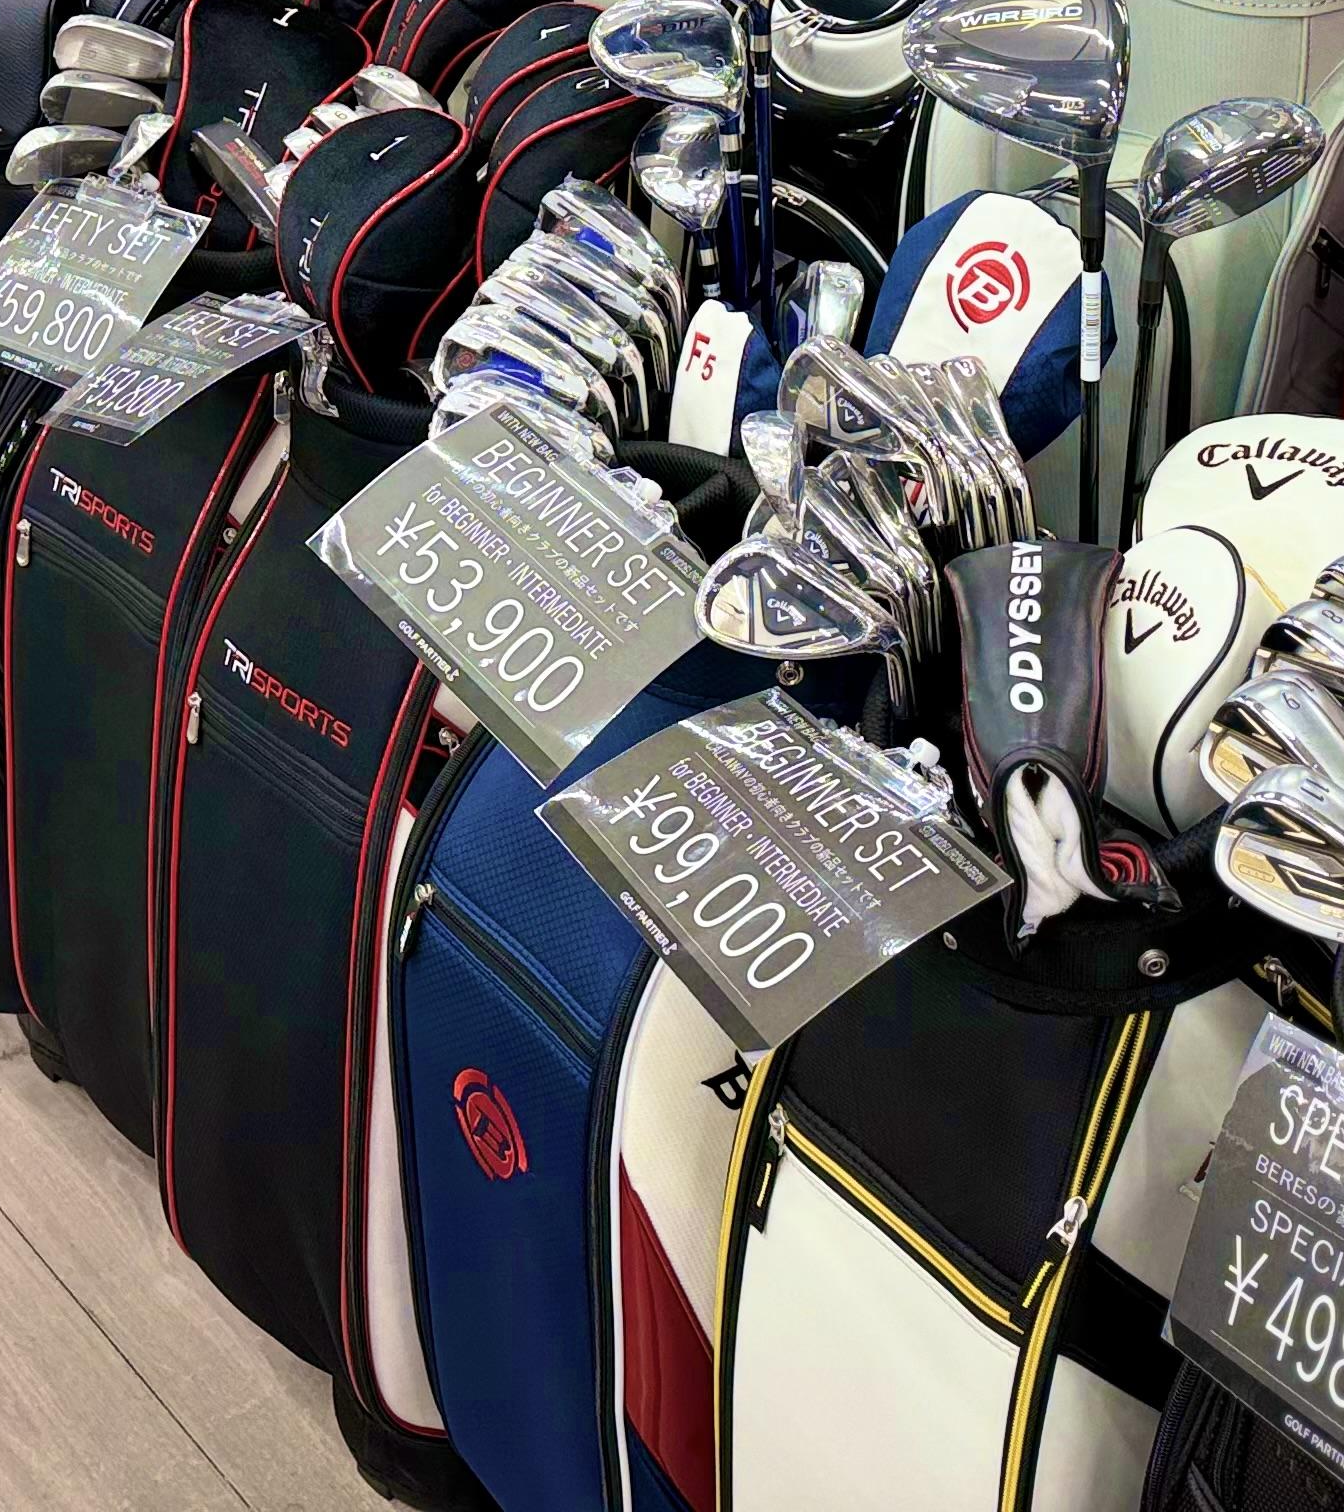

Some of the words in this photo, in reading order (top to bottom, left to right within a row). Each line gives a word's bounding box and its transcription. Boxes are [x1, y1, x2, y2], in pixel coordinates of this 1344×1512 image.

[958, 3, 1085, 32] WARBIRD
[29, 200, 106, 247] LEFTY
[106, 221, 171, 266] SET
[220, 321, 280, 349] SET
[78, 364, 186, 418] ¥59,800
[497, 409, 521, 435] WITH
[518, 427, 541, 450] NEW
[537, 442, 560, 464] BAG
[49, 466, 156, 556] TRISPORTS
[471, 438, 624, 568] BEGINNER
[607, 553, 687, 617] SET
[421, 482, 444, 505] for
[440, 493, 508, 565] BEGINNER
[507, 561, 613, 660] INTERMEDIATE
[376, 500, 586, 713] ¥53,900
[398, 619, 421, 641] GOLF
[1009, 539, 1045, 715] ODYSSEY
[1111, 569, 1202, 644] Callaway
[1321, 609, 1343, 625] 8
[222, 638, 353, 748] TRISPORTS
[735, 720, 880, 843] BEGINNER
[853, 830, 940, 893] SET
[609, 774, 815, 990] ¥99,000
[668, 757, 691, 781] for
[683, 769, 753, 839] BEGINNER
[746, 836, 850, 938] INTERMEDIATE
[620, 890, 644, 913] GOLF
[1268, 1033, 1299, 1064] WITH
[1283, 1413, 1313, 1444] GOLF
